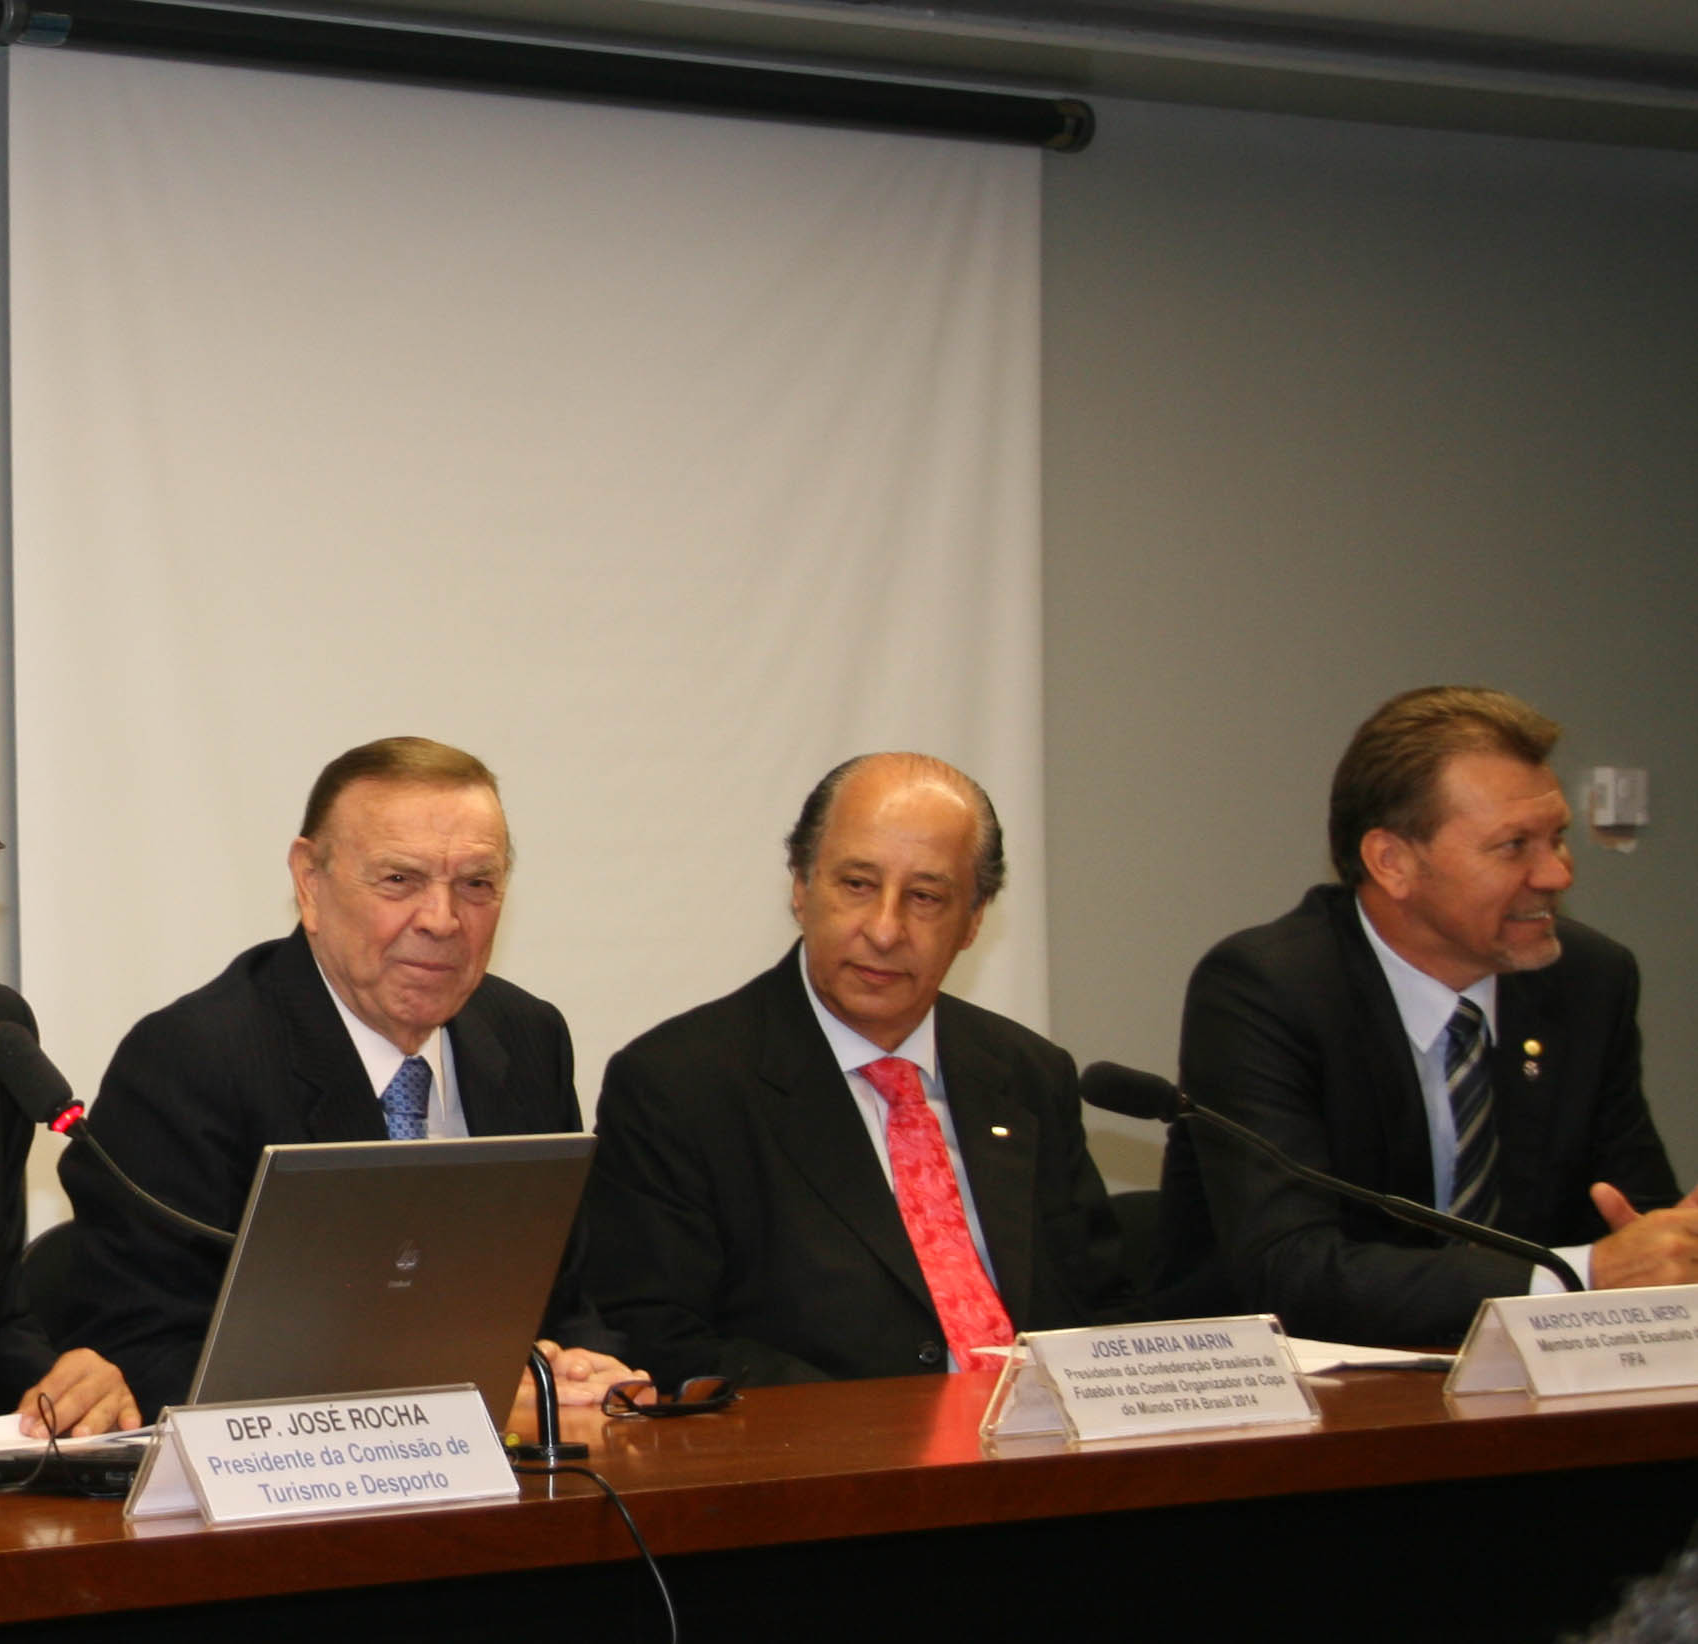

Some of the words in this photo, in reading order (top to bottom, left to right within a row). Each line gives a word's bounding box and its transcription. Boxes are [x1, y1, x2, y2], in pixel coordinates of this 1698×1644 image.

[1528, 1312, 1582, 1331] MARCO
[1582, 1309, 1621, 1327] POLO
[1621, 1307, 1652, 1323] DEL
[1650, 1305, 1690, 1321] NERO
[1092, 1335, 1131, 1358] JOSÉ
[1131, 1336, 1183, 1354] MARIA
[1183, 1333, 1233, 1350] MARIN
[1063, 1365, 1123, 1380] Presidente
[1124, 1364, 1138, 1376] da
[1138, 1359, 1211, 1375] Confederação
[1211, 1355, 1262, 1370] Brasileira
[1263, 1355, 1276, 1367] de
[1619, 1351, 1646, 1368] FIFA
[1073, 1384, 1115, 1399] Futebol
[1117, 1386, 1124, 1396] e
[1125, 1383, 1140, 1396] do
[1140, 1379, 1178, 1394] Comitê
[1178, 1377, 1242, 1394] Organizador
[1244, 1375, 1258, 1387] da
[1258, 1374, 1286, 1388] Copa
[1121, 1403, 1136, 1416] do
[1136, 1400, 1174, 1415] Mundo
[1174, 1398, 1200, 1412] FIFA
[1200, 1395, 1232, 1410] Brasil
[1233, 1394, 1258, 1408] 2014
[227, 1418, 282, 1441] DEP.
[287, 1404, 346, 1436] JOSÉ
[349, 1403, 429, 1430] ROCHA
[207, 1447, 316, 1476] Presidente
[321, 1445, 345, 1467] da
[349, 1438, 441, 1464] Comissão
[445, 1435, 470, 1456] de
[258, 1478, 342, 1504] Turismo
[347, 1478, 359, 1496] e
[362, 1469, 449, 1498] Desporto
